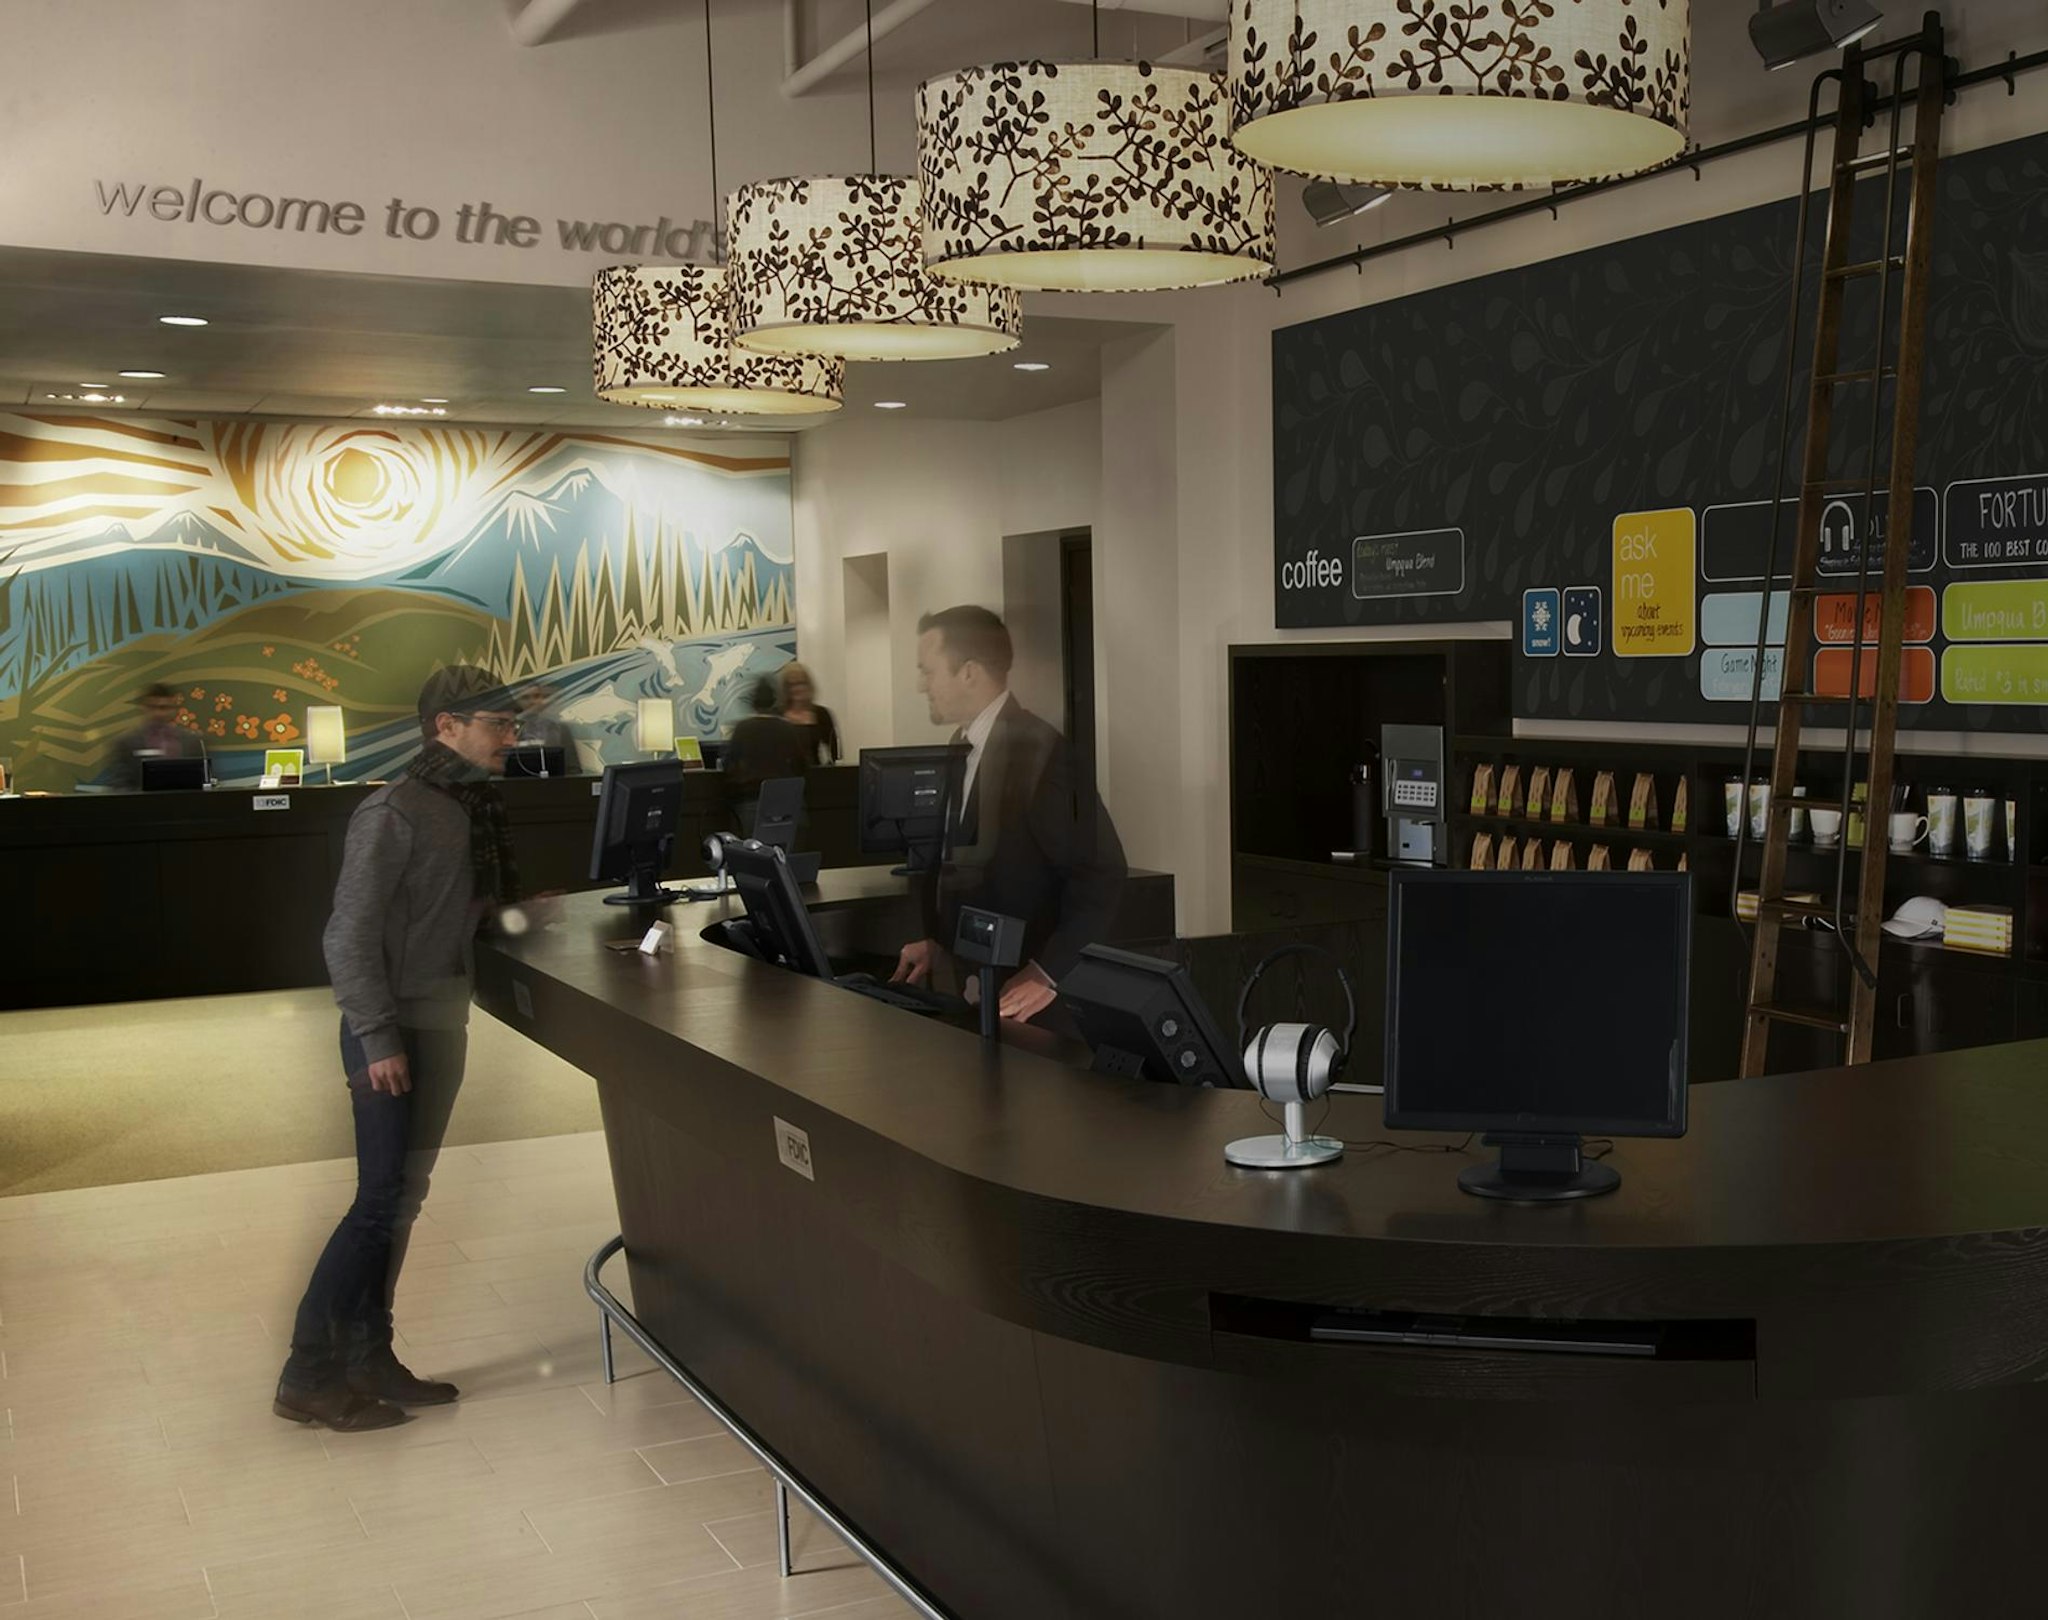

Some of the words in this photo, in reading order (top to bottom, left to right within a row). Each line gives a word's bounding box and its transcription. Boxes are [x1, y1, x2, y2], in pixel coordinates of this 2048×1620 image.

[95, 178, 365, 236] welcome
[386, 197, 439, 240] to
[454, 202, 541, 249] the
[1979, 487, 2048, 530] FORTU
[1620, 525, 1657, 563] ask
[1960, 542, 1979, 559] THE
[1984, 541, 2001, 559] 100
[2006, 538, 2030, 557] BEST
[1282, 549, 1343, 590] coffee
[1621, 571, 1655, 600] me
[1637, 602, 1661, 620] about
[1962, 602, 2025, 636] Umpqua
[1720, 653, 1749, 674] Game
[266, 798, 287, 807] FDIC
[787, 1135, 809, 1165] FDIC
